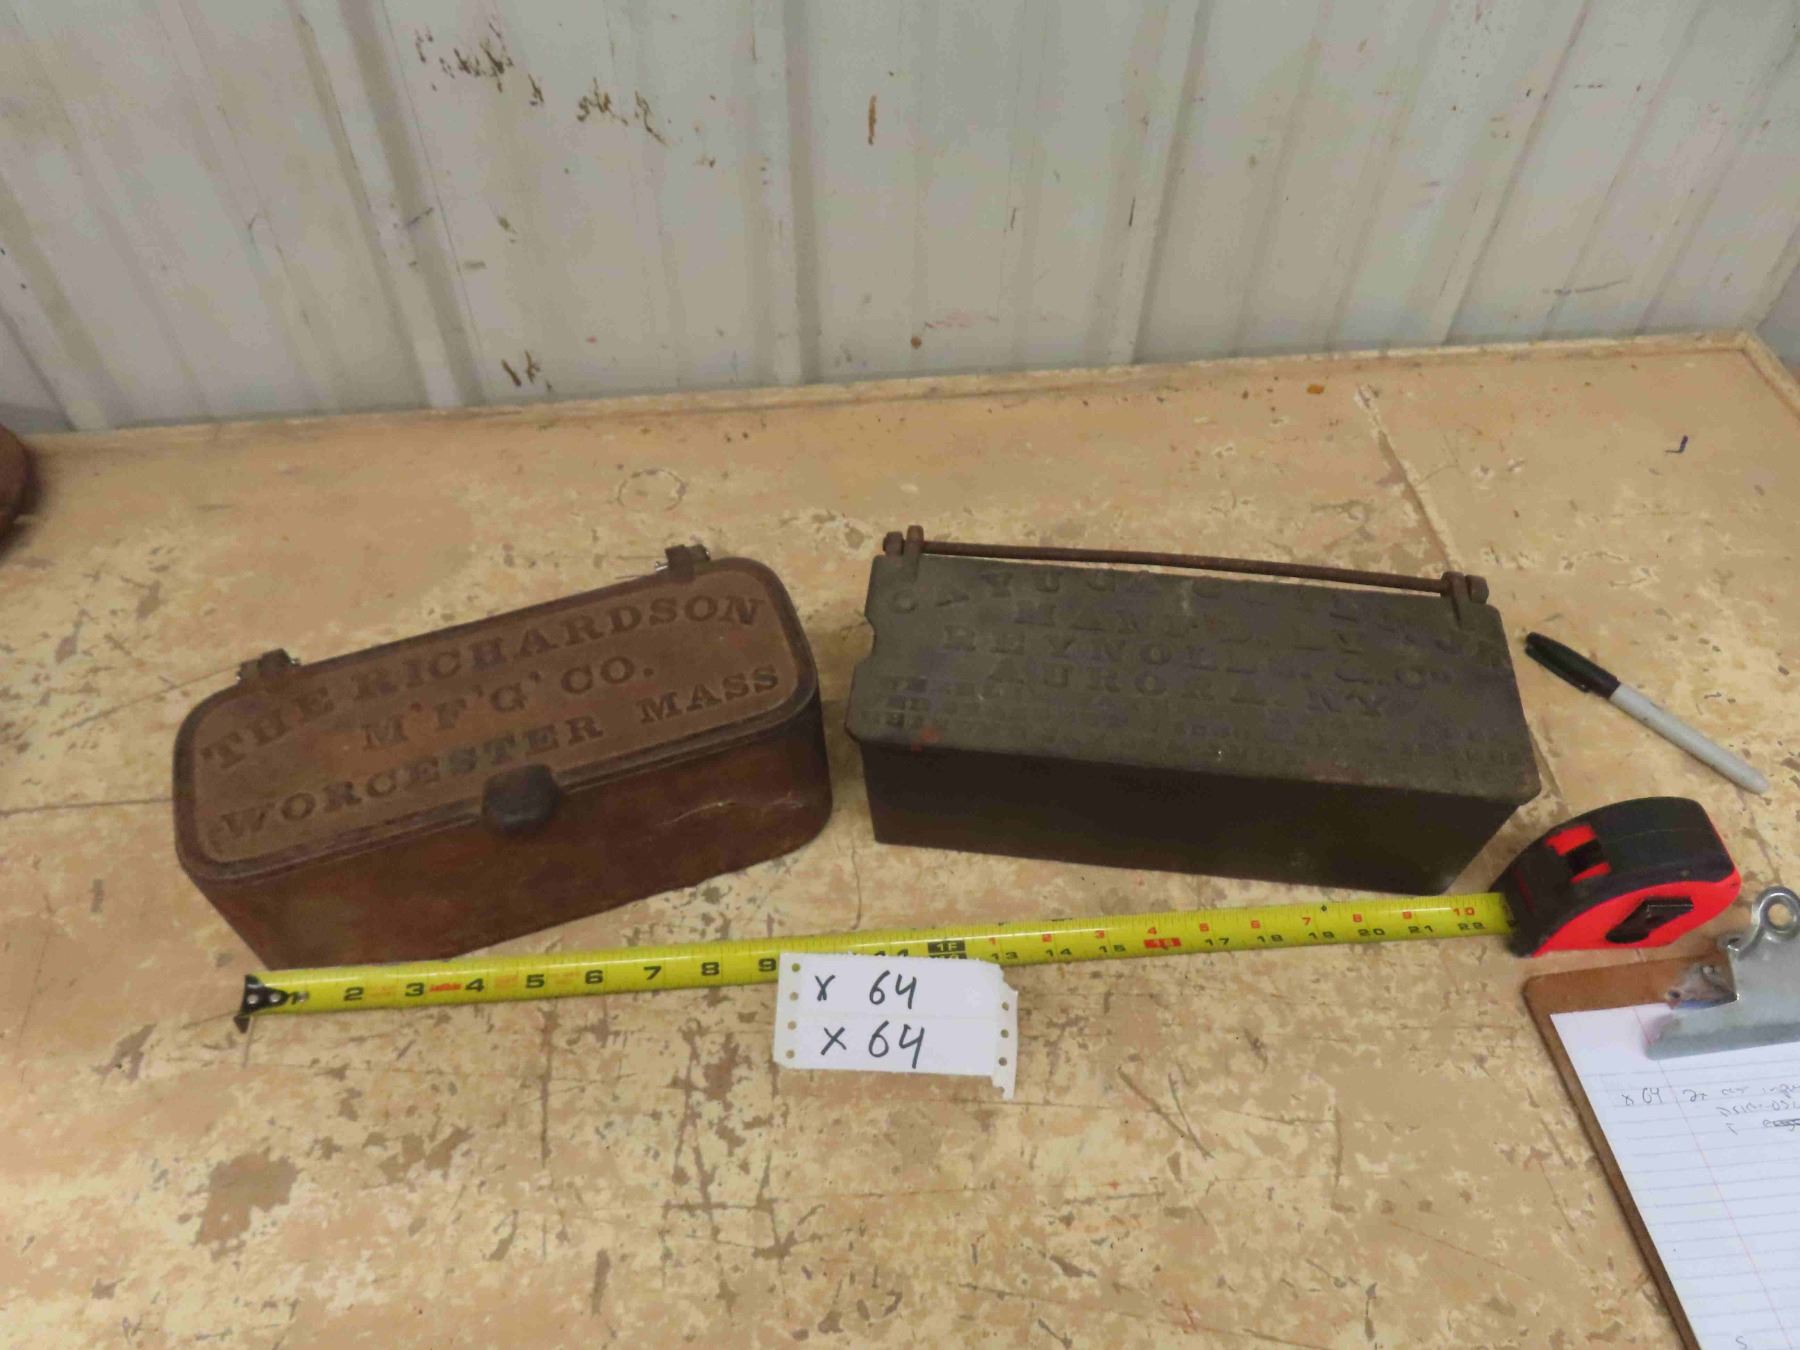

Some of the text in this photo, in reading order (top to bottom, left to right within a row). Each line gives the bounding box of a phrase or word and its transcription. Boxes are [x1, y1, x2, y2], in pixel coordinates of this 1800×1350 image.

[199, 595, 758, 769] THE RICHARDSON
[219, 664, 779, 839] WORCESTER MASS
[344, 987, 364, 1001] 2
[405, 982, 425, 997] 3
[465, 978, 485, 992] 4
[526, 974, 545, 989] 5
[585, 970, 603, 984] 6
[643, 966, 662, 980] 7
[701, 962, 720, 976] 8
[758, 958, 777, 972] 9
[1358, 928, 1386, 937] 20
[869, 970, 917, 1010] 64
[868, 1020, 925, 1069] 64
